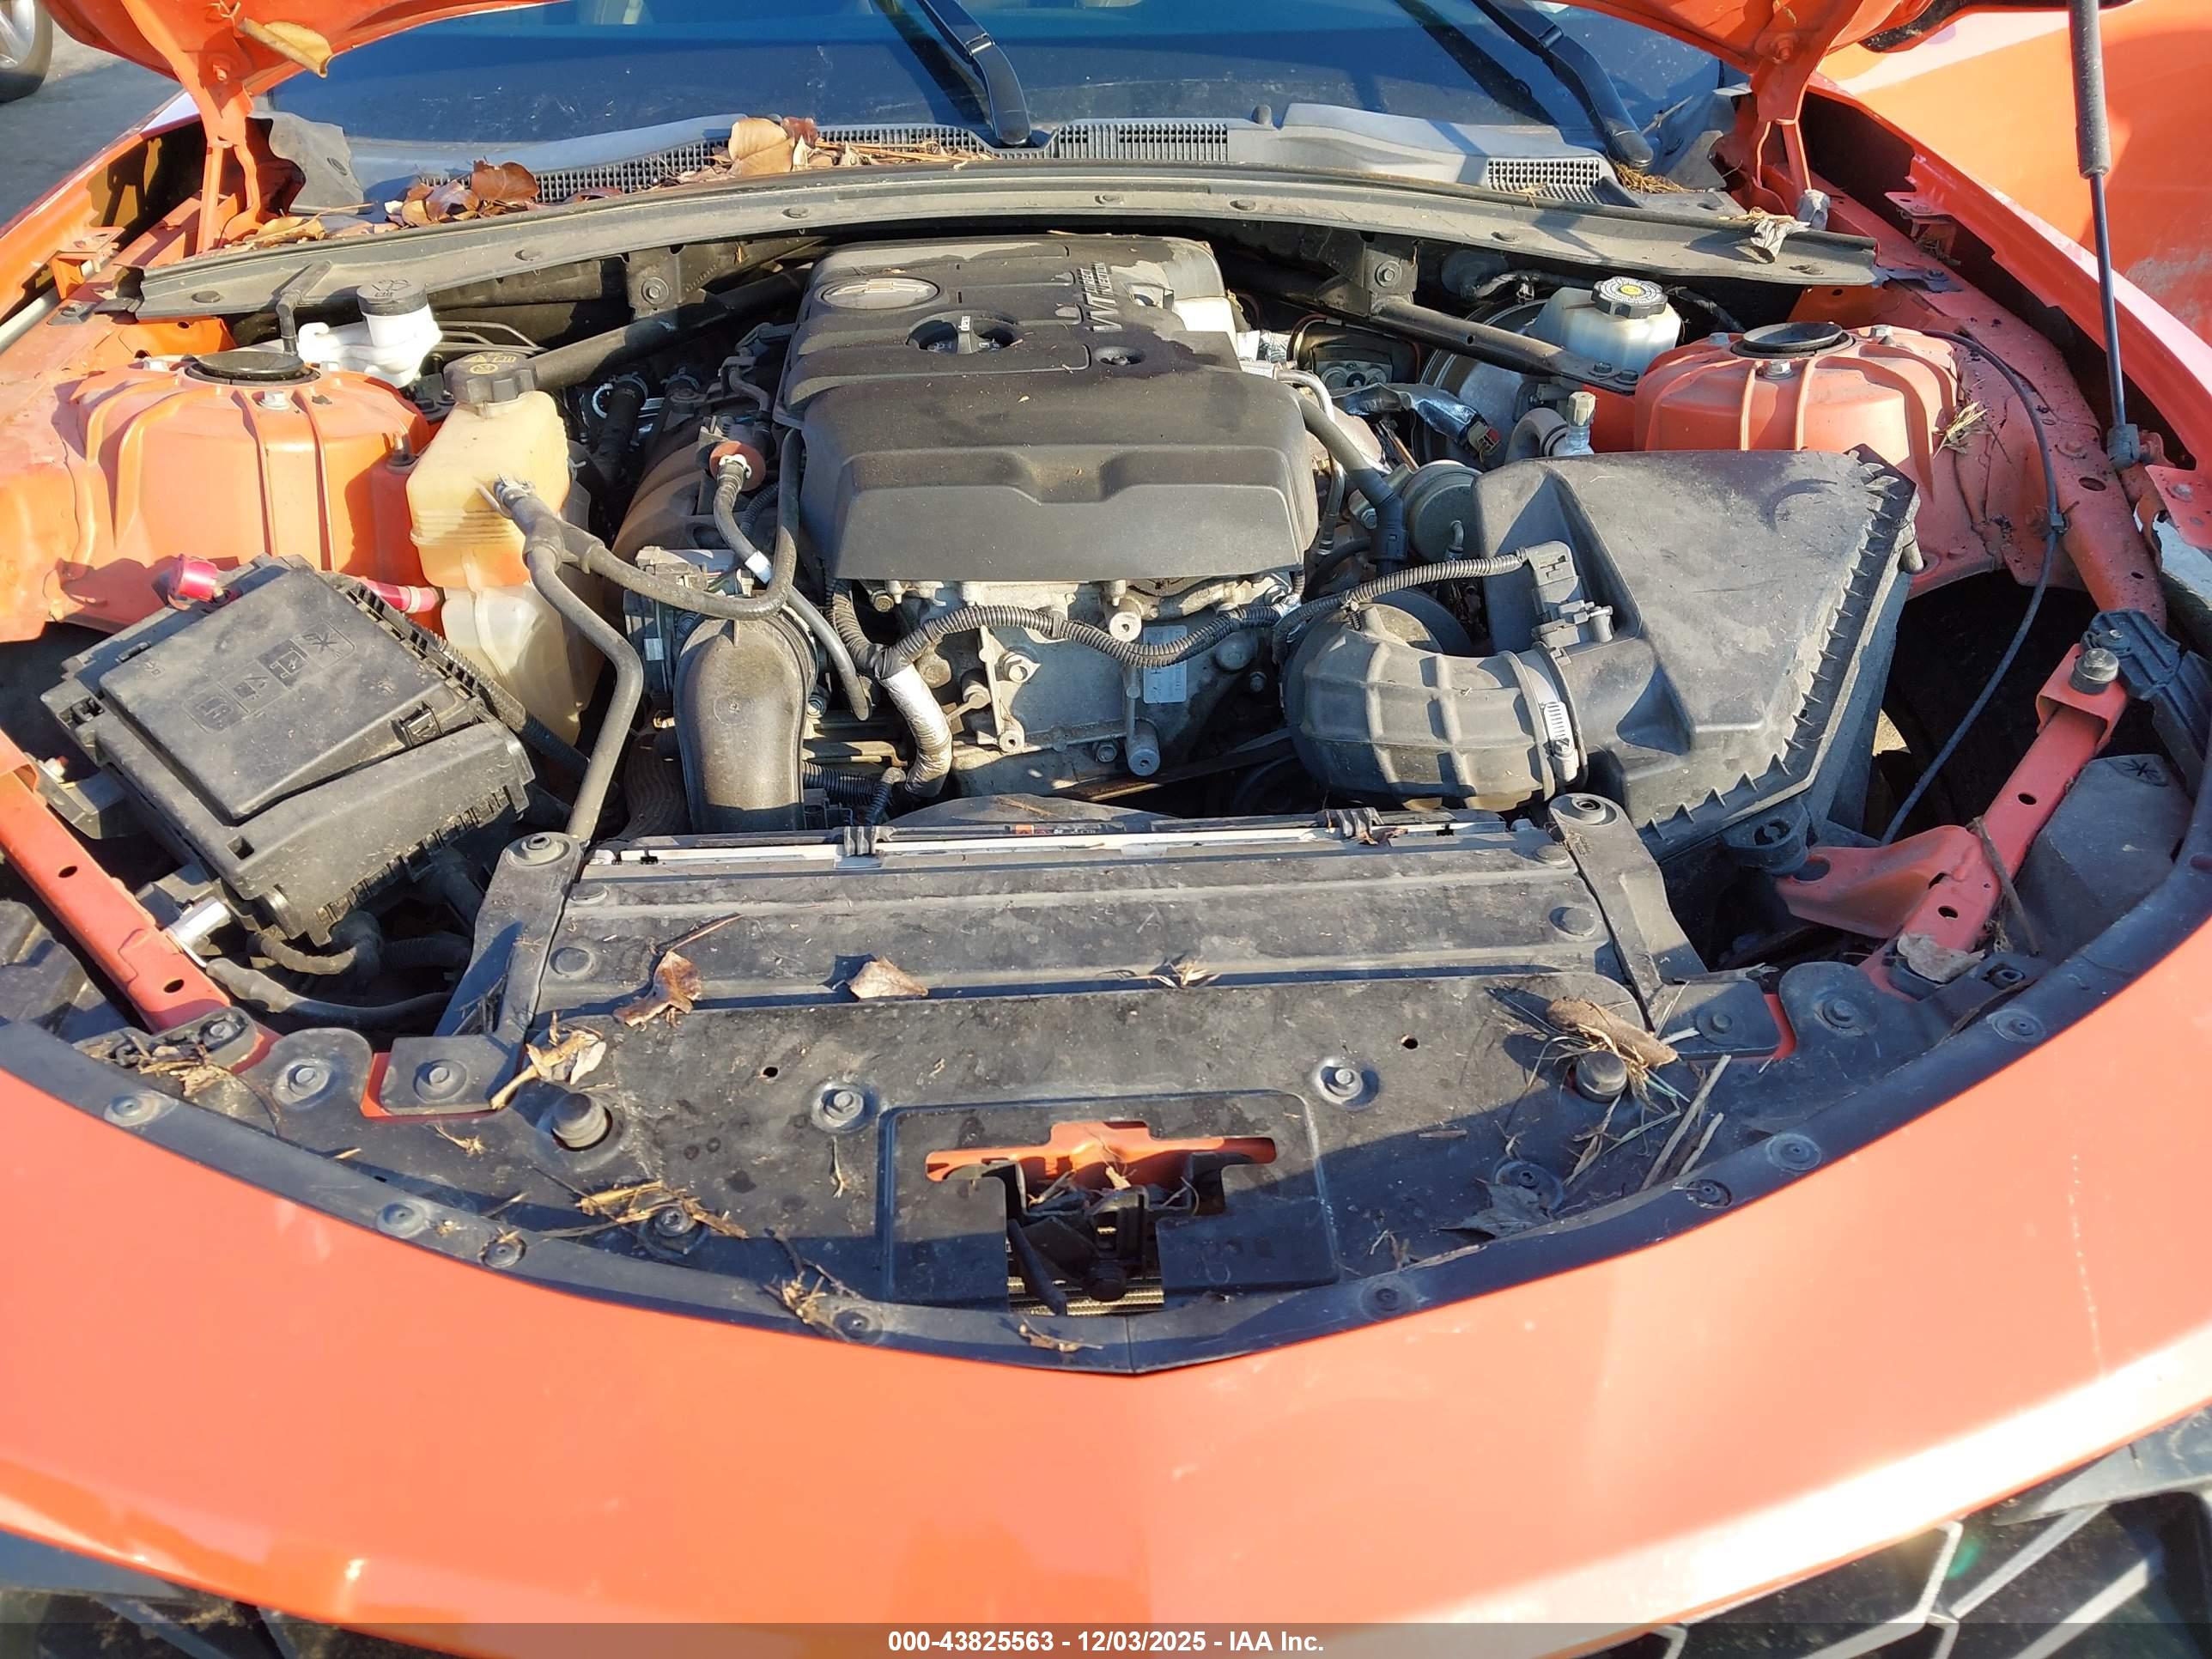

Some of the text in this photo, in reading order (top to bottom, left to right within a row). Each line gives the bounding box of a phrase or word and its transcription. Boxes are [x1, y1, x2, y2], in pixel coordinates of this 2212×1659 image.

[1079, 267, 1098, 295] DIRECT
[1094, 262, 1114, 296] INJECTION
[1085, 292, 1123, 331] VVT
